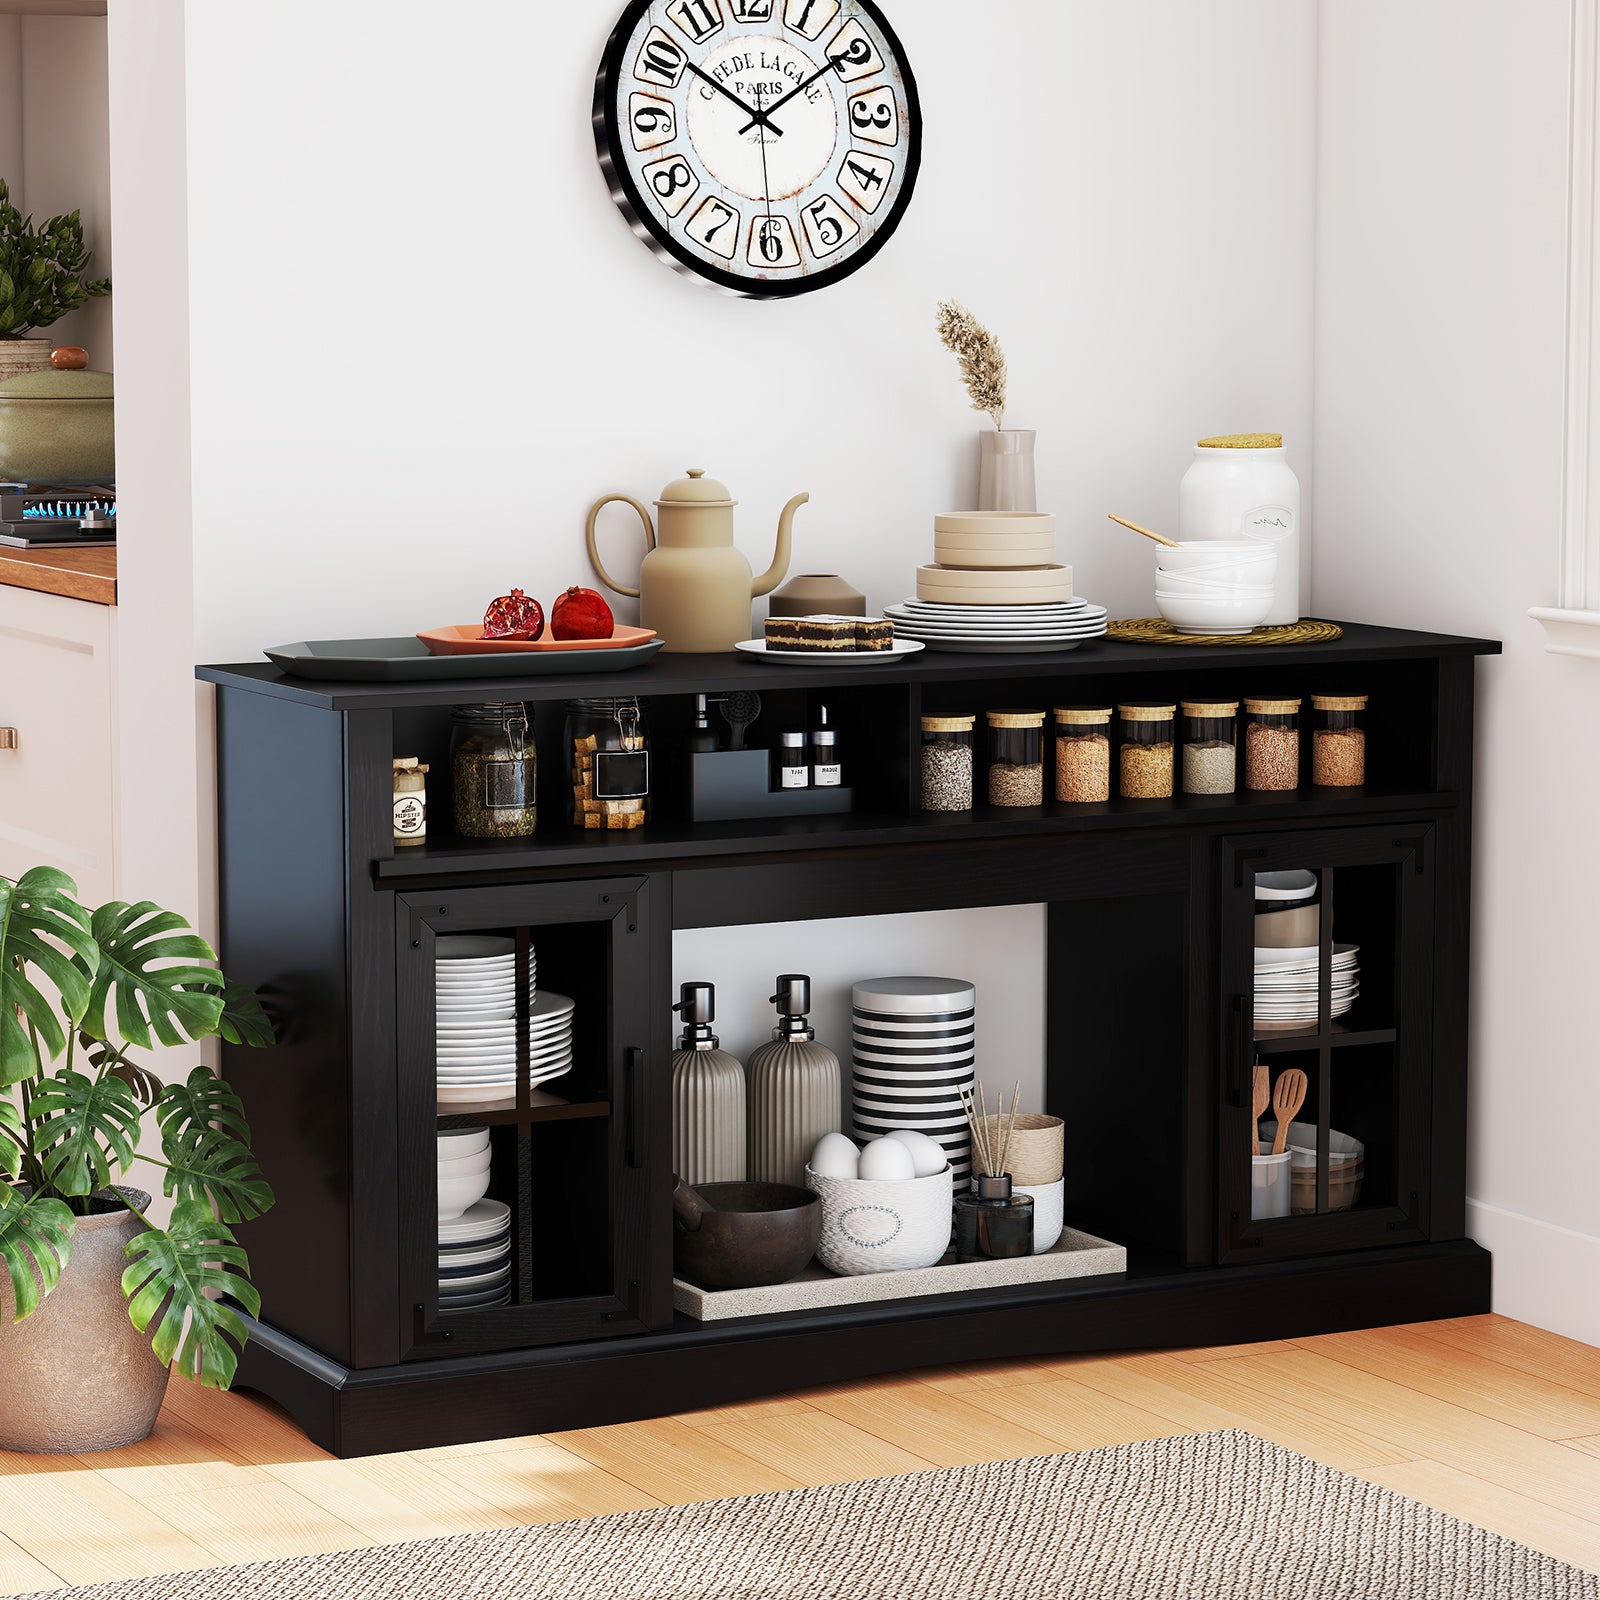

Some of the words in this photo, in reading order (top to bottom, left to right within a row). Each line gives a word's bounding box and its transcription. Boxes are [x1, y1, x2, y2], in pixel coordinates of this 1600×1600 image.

[678, 0, 722, 41] 11
[643, 40, 682, 86] 10
[830, 38, 872, 73] 2
[735, 81, 783, 95] PARIS
[633, 106, 673, 134] 9
[851, 101, 892, 129] 3
[652, 162, 691, 198] 8
[847, 159, 884, 191] 4
[705, 203, 734, 243] 7
[759, 219, 783, 263] 6
[810, 201, 843, 246] 5
